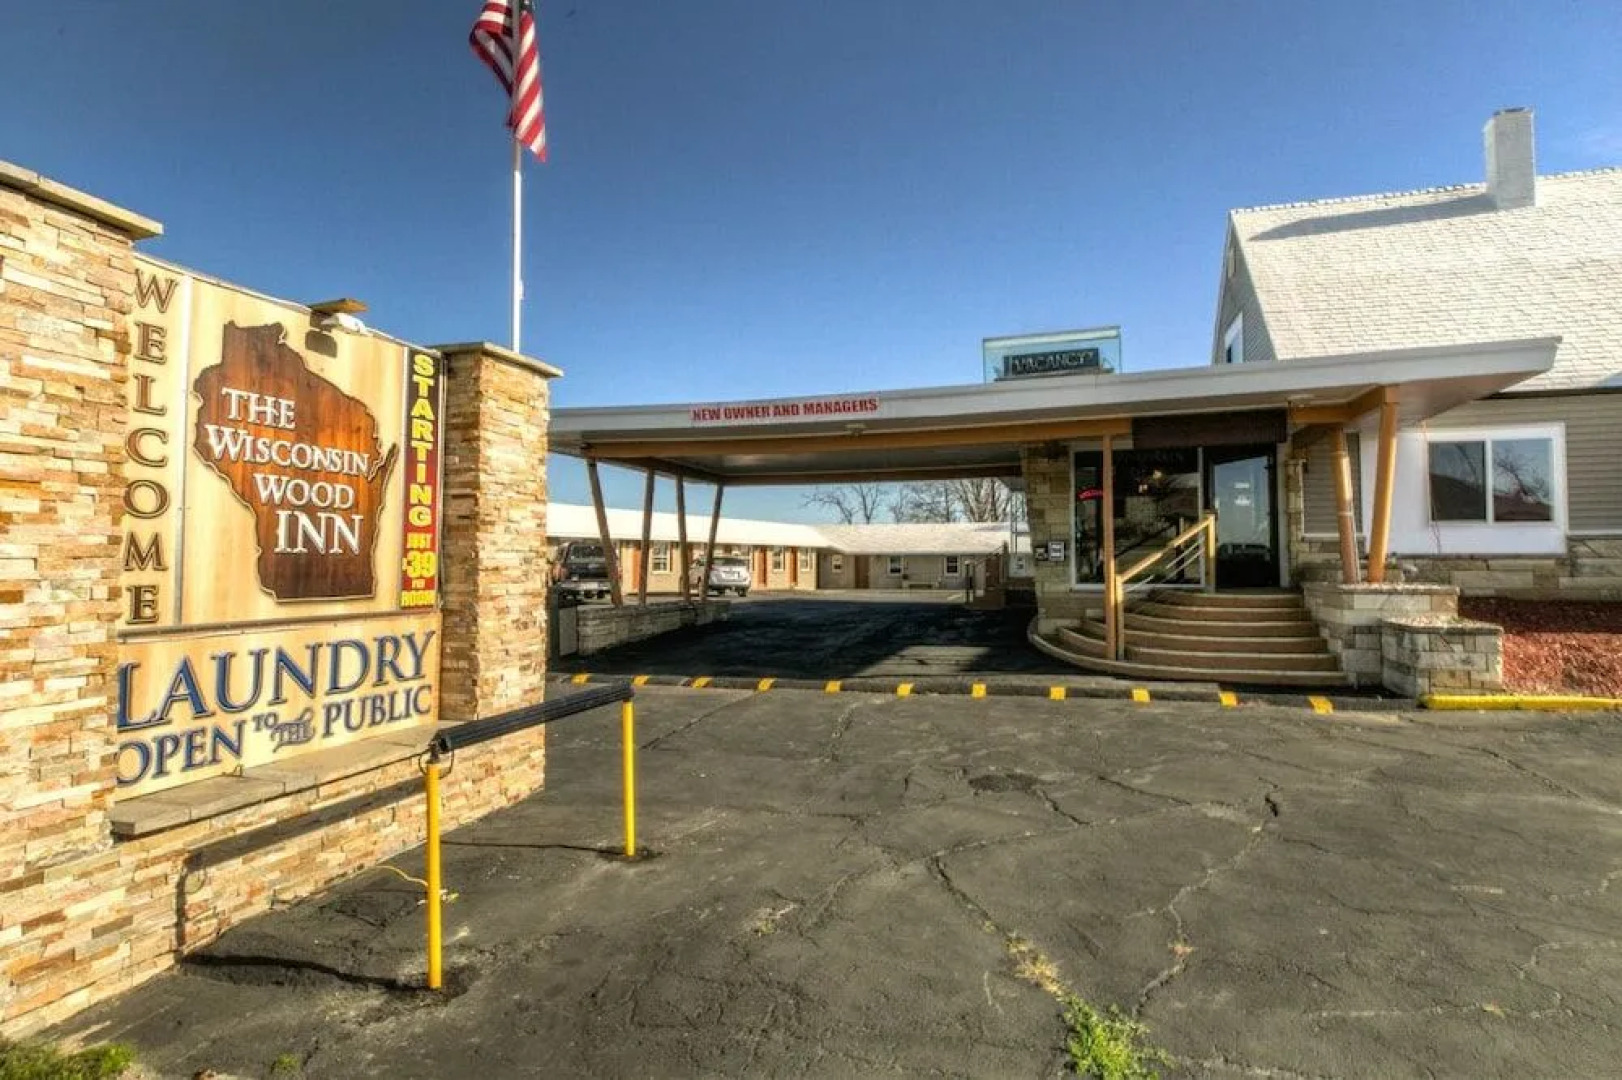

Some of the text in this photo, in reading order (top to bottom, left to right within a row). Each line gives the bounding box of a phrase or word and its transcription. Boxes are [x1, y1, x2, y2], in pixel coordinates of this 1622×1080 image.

[221, 387, 296, 429] THE
[692, 399, 878, 421] NEW OWNER AND MANAGERS
[123, 267, 178, 624] WELCOME
[204, 424, 371, 476] WISCONSIN
[408, 353, 435, 527] STARTING
[253, 473, 355, 509] WOOD
[273, 510, 364, 555] INN
[117, 630, 436, 732] LAUNDRY
[117, 684, 433, 788] OPEN TO THE PUBLIC
